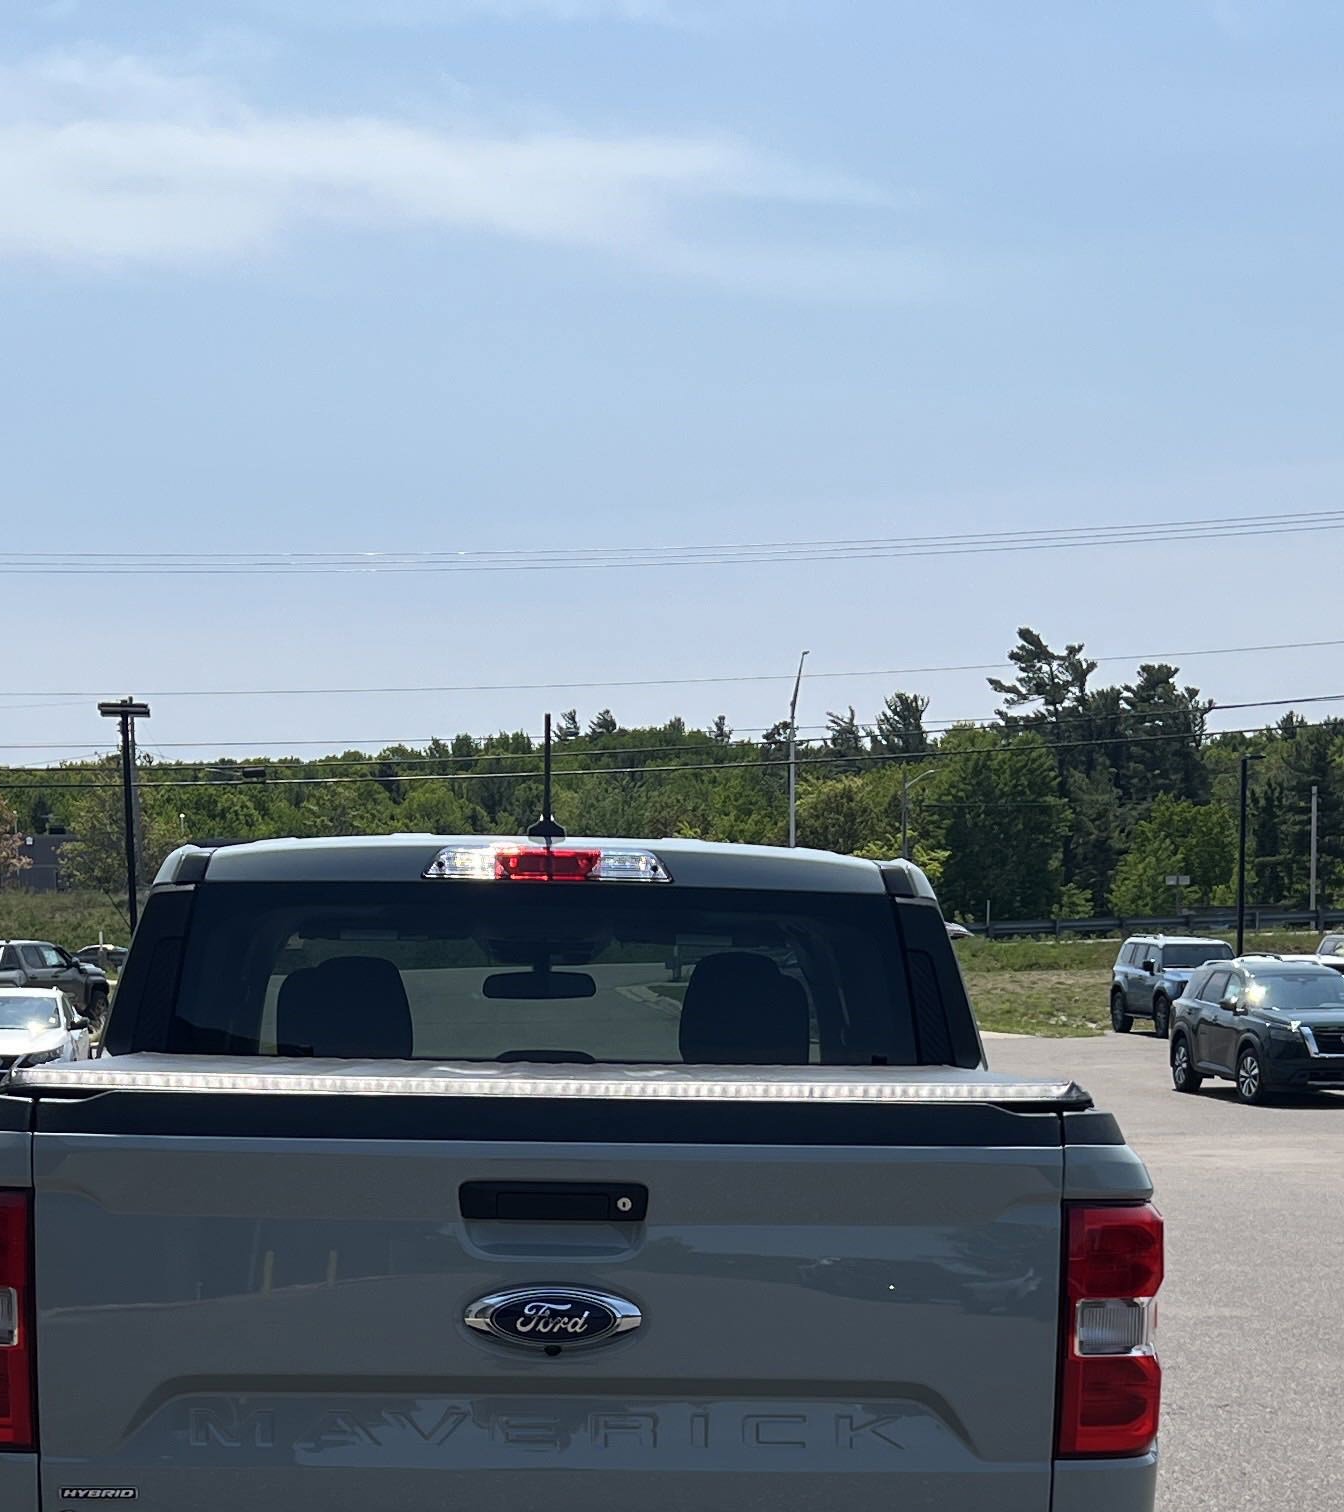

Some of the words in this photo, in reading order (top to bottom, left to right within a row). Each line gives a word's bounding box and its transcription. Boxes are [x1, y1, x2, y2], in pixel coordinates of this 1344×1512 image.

[515, 1301, 591, 1334] Ford
[189, 1408, 906, 1451] MAVERICK
[63, 1489, 135, 1498] HYBRID
